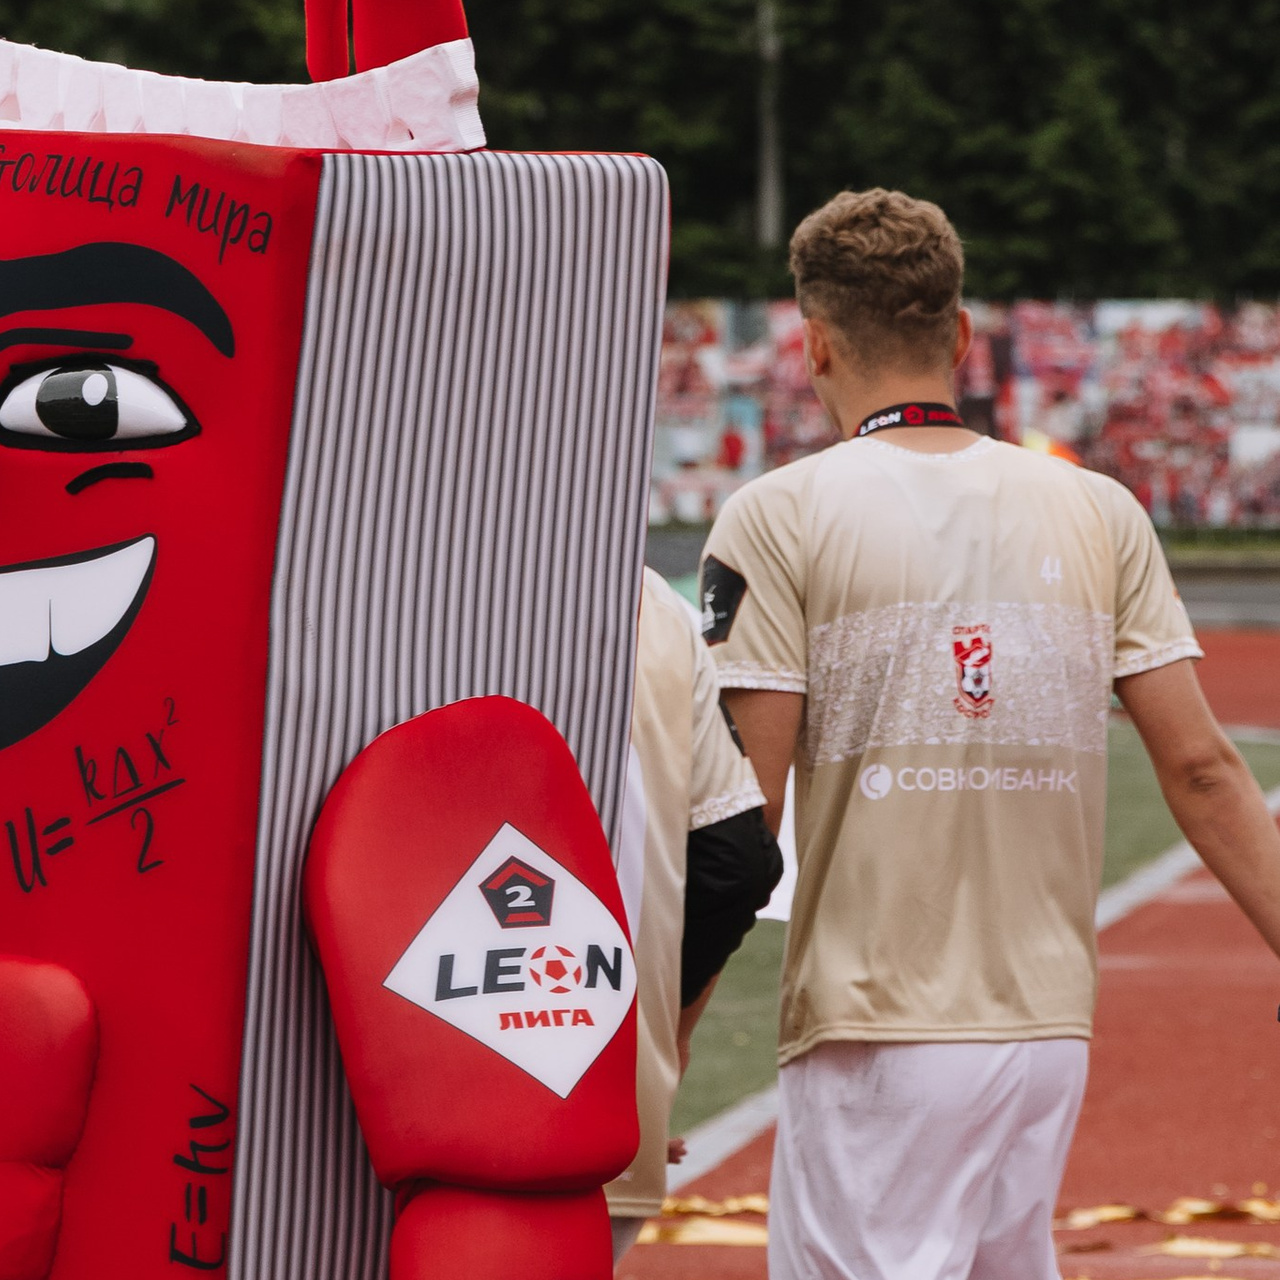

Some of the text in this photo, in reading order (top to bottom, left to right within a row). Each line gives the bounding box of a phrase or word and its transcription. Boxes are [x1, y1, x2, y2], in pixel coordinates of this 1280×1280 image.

[165, 174, 273, 264] мира
[505, 885, 536, 908] 2
[435, 944, 623, 1002] LEON
[499, 1008, 595, 1031] ЛИГА
